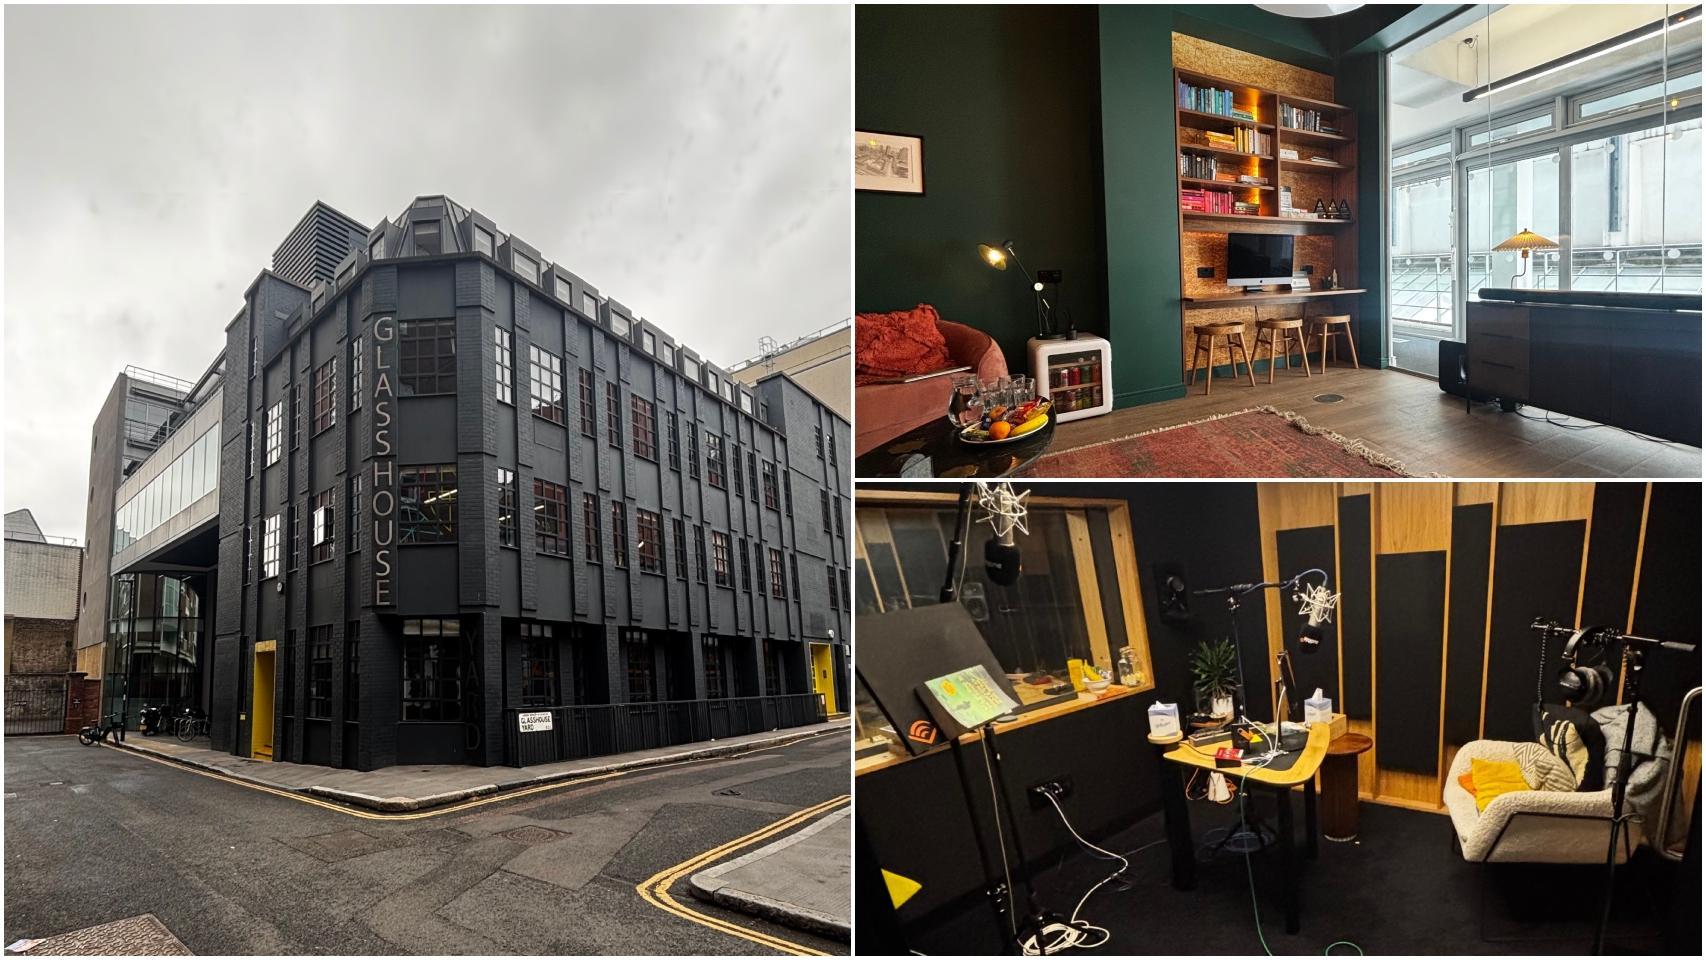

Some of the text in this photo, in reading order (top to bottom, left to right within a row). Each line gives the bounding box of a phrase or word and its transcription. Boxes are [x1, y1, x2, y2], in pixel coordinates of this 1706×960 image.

[372, 316, 394, 606] GLASSHOUSE
[465, 629, 481, 751] YARD
[521, 715, 551, 724] GLASSHOUSE
